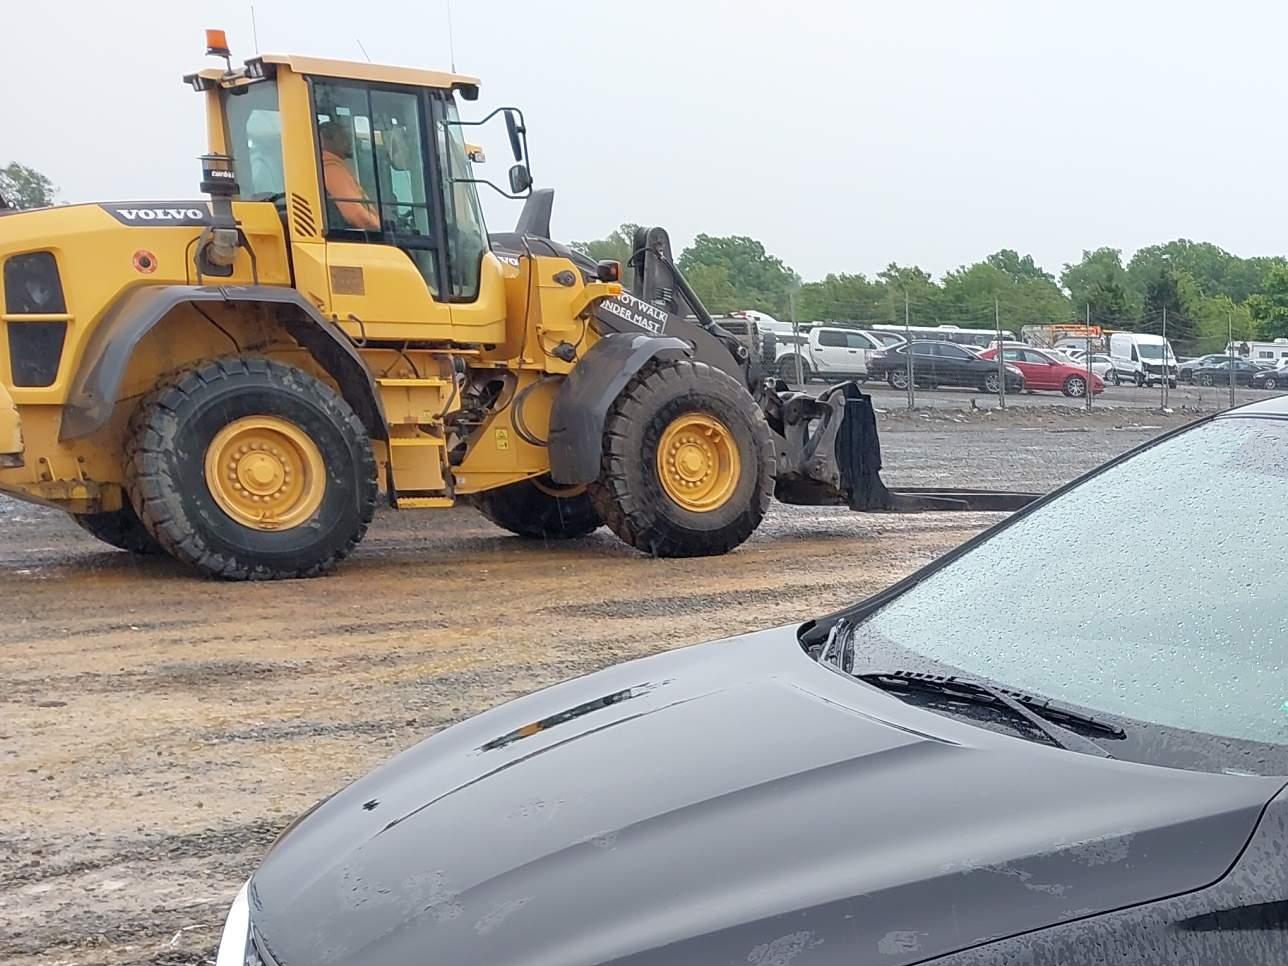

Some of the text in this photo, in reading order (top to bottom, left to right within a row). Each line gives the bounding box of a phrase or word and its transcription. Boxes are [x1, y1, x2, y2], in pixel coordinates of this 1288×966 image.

[117, 208, 203, 220] VOLVO
[638, 302, 666, 323] WALK
[633, 313, 660, 333] MAST
